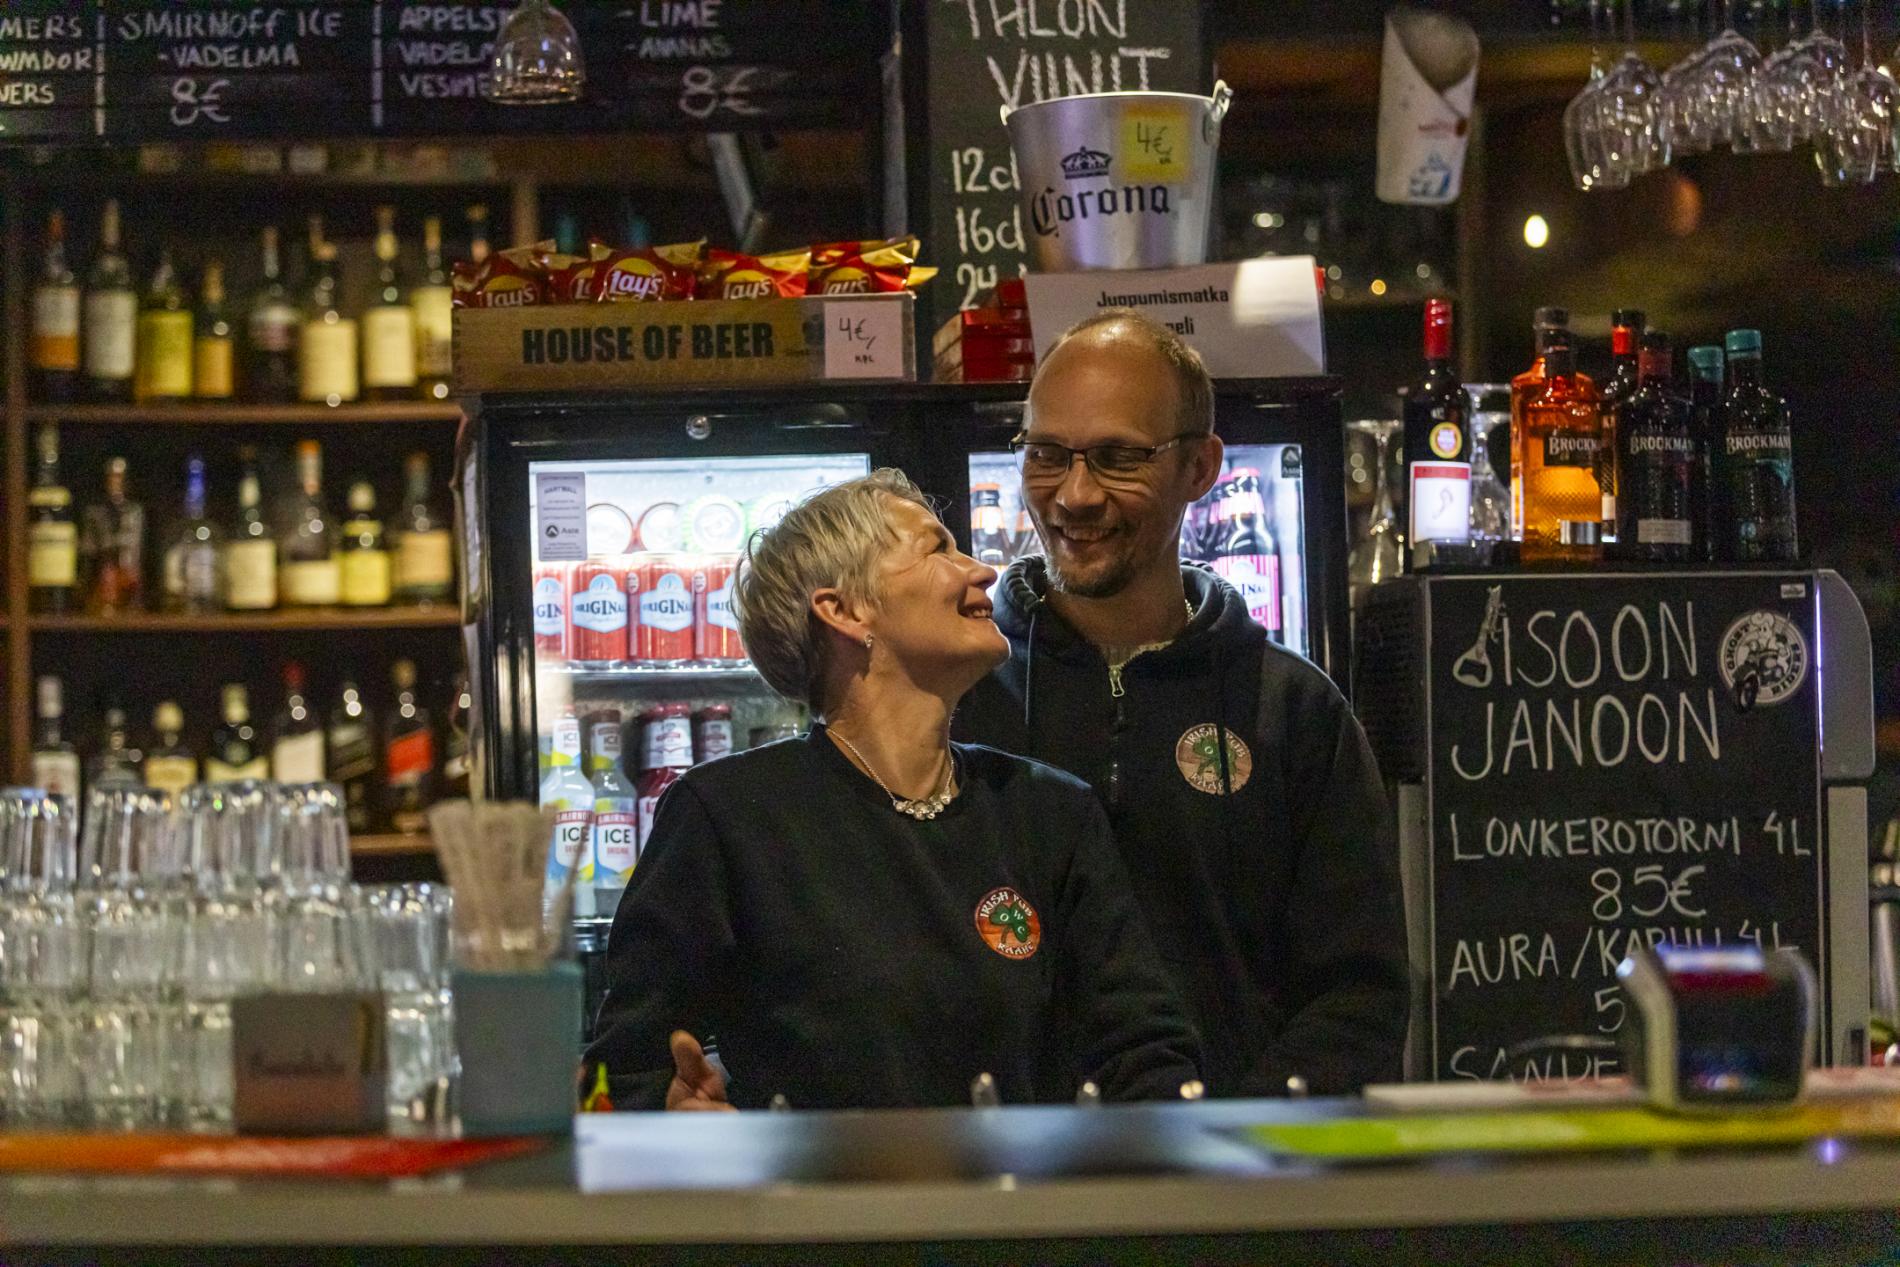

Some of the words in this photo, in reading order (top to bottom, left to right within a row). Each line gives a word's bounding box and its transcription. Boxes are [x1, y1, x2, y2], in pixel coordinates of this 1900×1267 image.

[117, 8, 286, 40] SMIRNOFF
[296, 7, 343, 37] ICE
[170, 77, 231, 126] 8€
[1031, 184, 1170, 238] Corona
[1096, 286, 1229, 308] Juopumismatka
[522, 326, 635, 365] HOUSE
[642, 324, 682, 362] OF
[691, 322, 774, 360] BEER
[1502, 601, 1697, 688] ISOON
[1184, 726, 1218, 746] IRISH
[1451, 688, 1720, 780] JANOON
[562, 827, 590, 842] ICE
[605, 829, 631, 844] ICE
[1450, 813, 1742, 861] LONKEROTORNI
[1763, 810, 1811, 857] 4L
[979, 891, 1009, 918] IRISH
[1013, 893, 1033, 917] PUB
[1591, 865, 1707, 921] 85€
[1449, 933, 1560, 991] AURA
